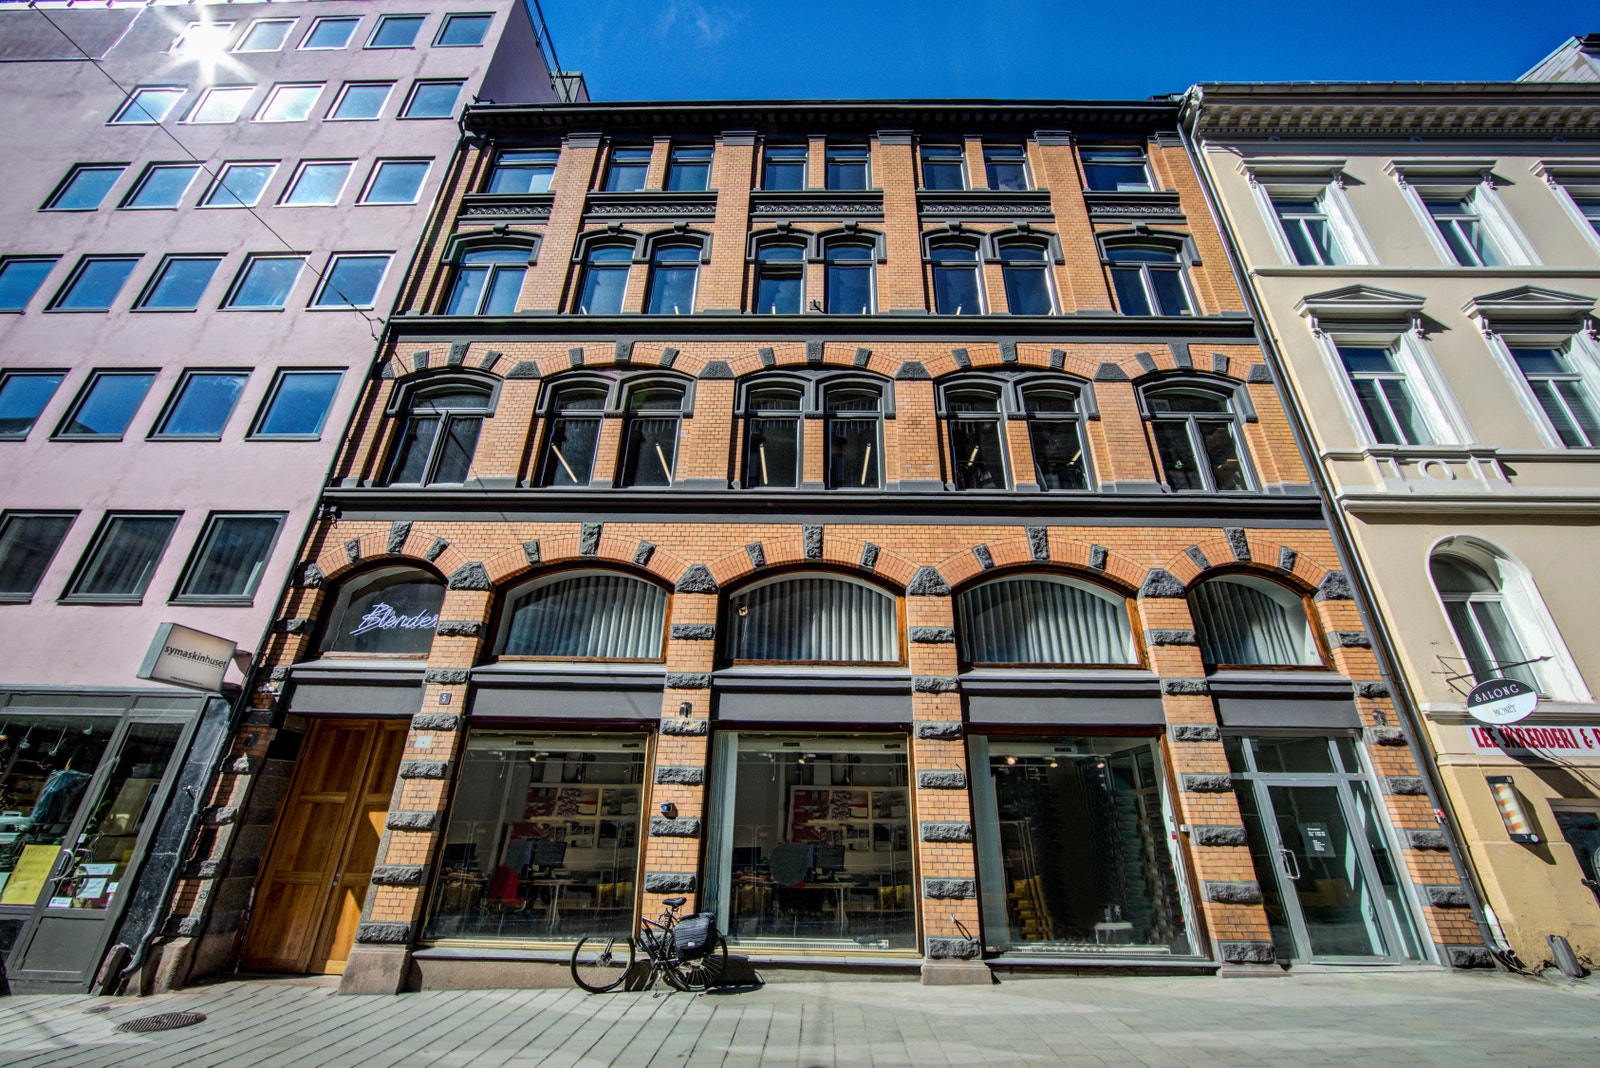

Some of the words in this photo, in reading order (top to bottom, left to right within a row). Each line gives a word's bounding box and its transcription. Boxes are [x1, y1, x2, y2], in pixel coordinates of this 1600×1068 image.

[164, 645, 227, 669] symaskinhuset
[1475, 684, 1519, 703] SALONG
[1471, 727, 1500, 749] LEE
[1497, 727, 1581, 749] SKREDDERI
